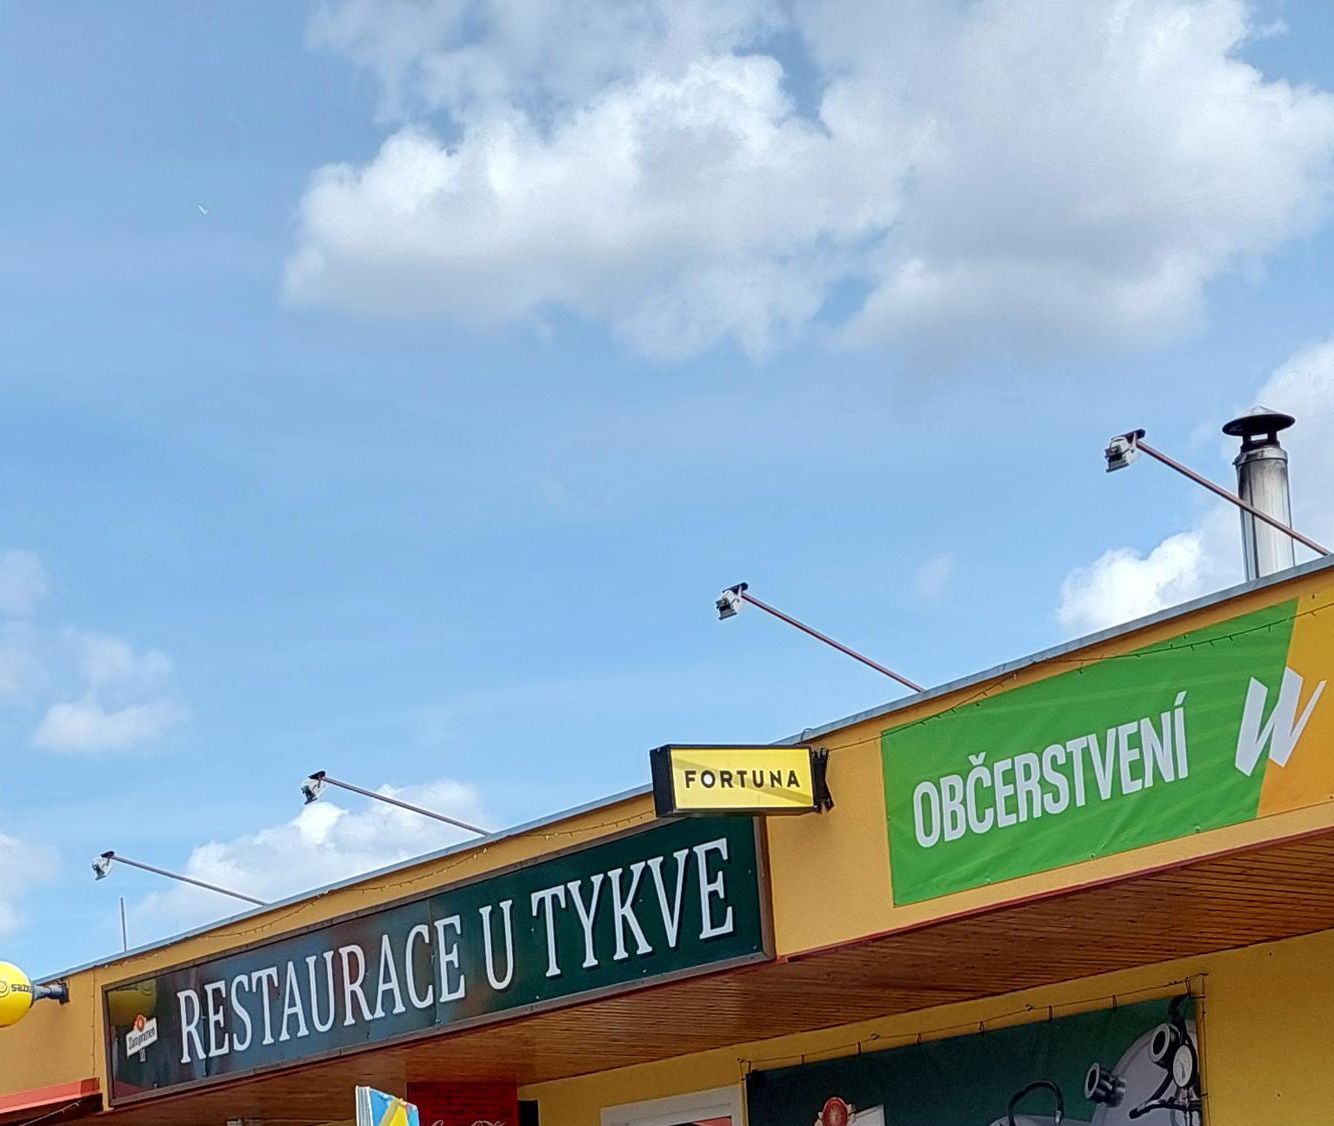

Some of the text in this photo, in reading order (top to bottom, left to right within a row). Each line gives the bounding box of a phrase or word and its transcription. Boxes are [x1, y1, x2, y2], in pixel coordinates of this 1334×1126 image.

[684, 770, 800, 789] FORTUNA
[912, 690, 1190, 849] OBČERSTVENÍ
[176, 837, 735, 1065] RESTAURACE U TYKVE
